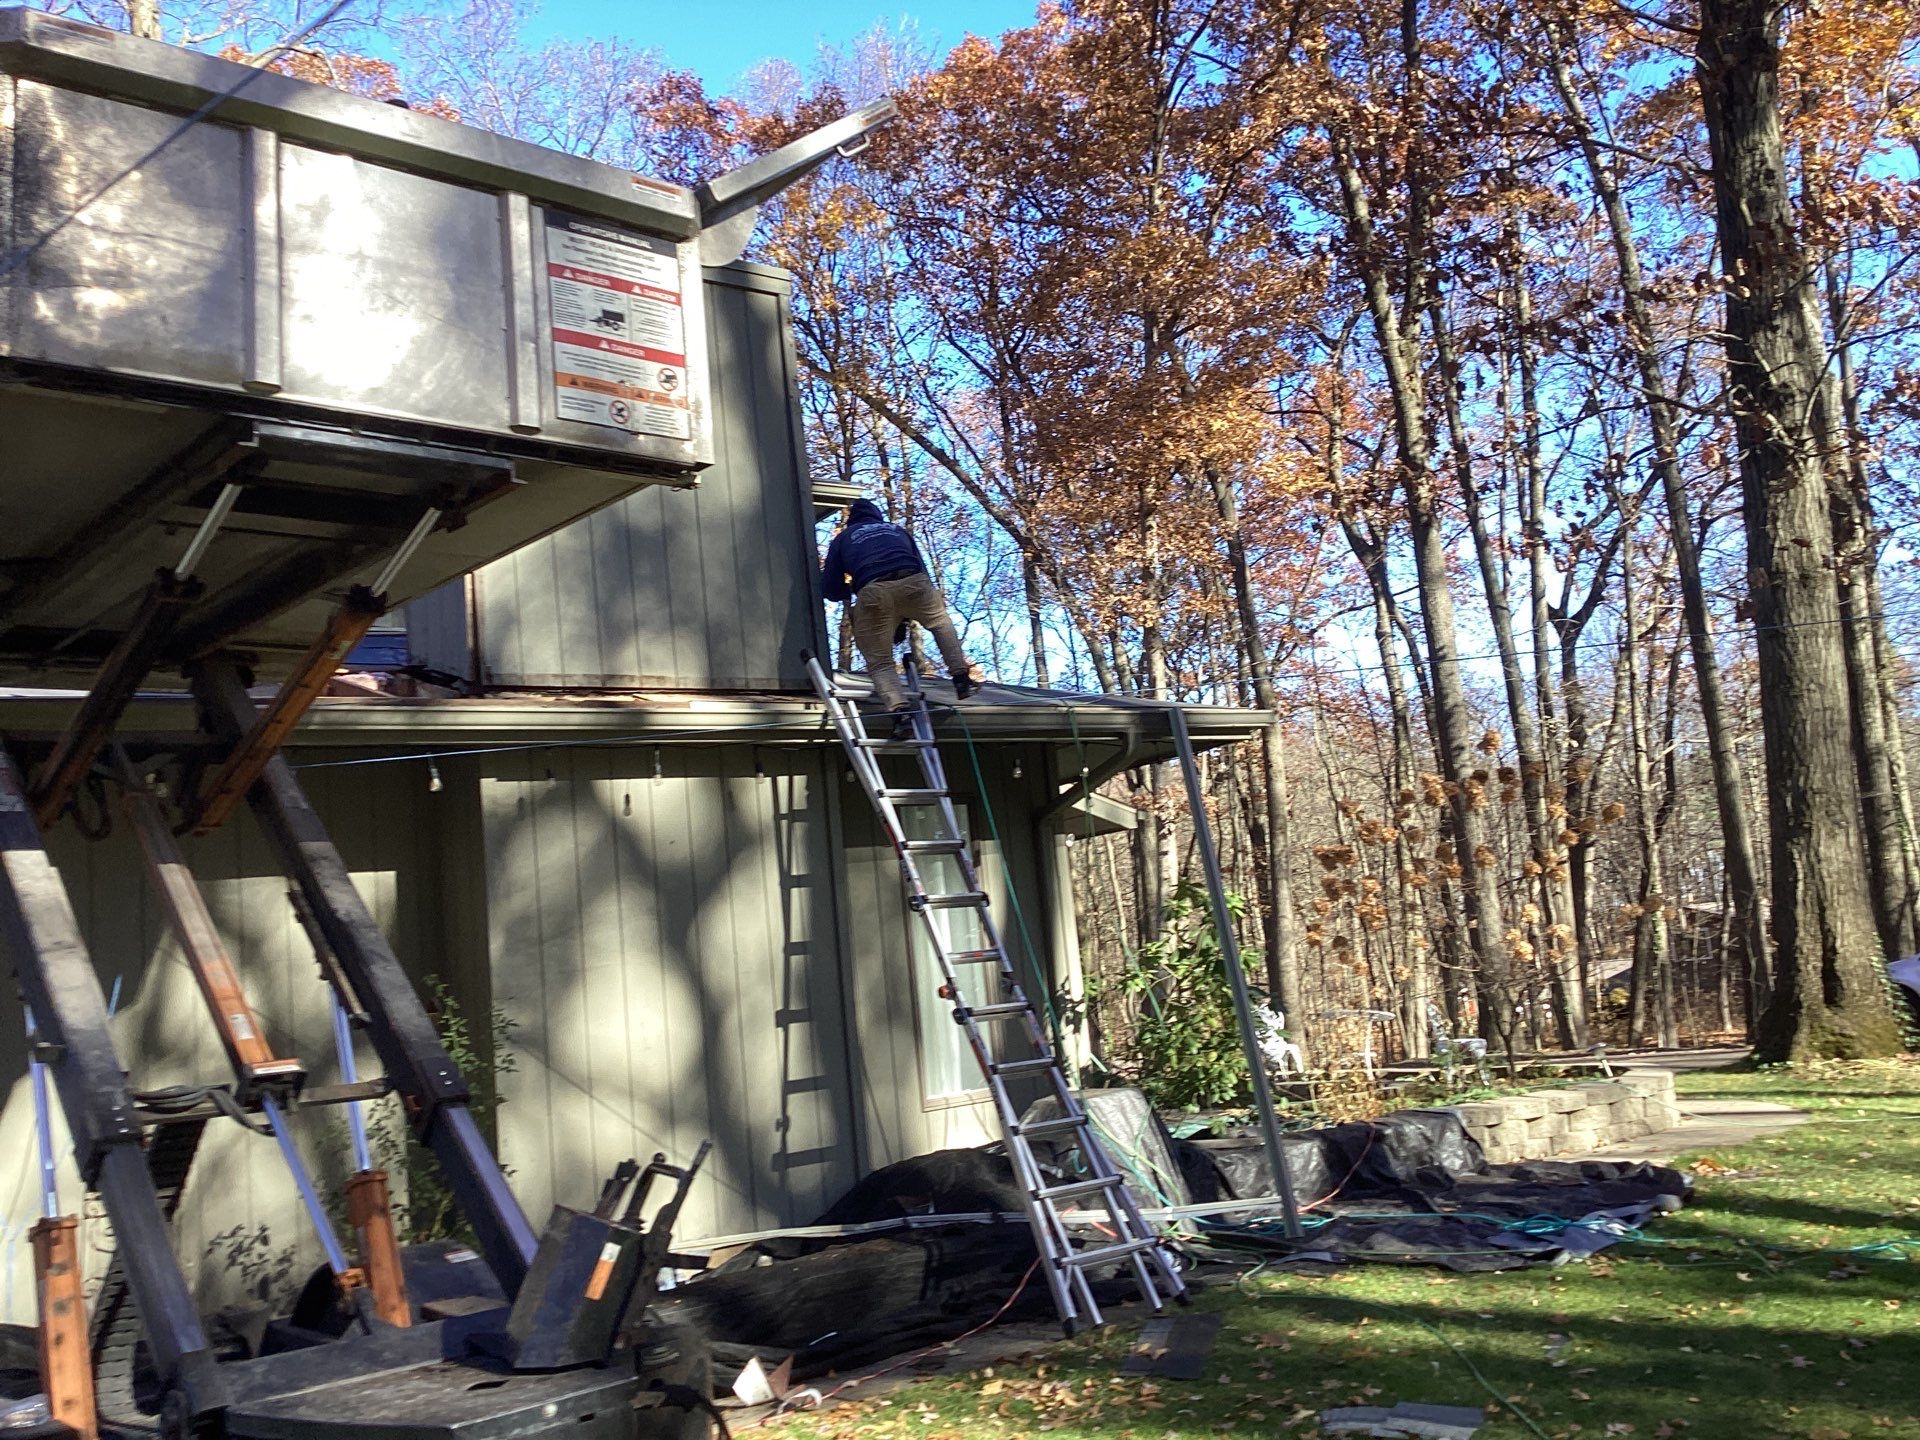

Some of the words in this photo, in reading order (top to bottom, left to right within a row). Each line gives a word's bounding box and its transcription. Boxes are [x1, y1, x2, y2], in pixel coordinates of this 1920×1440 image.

[573, 272, 612, 287] DANGER
[641, 288, 677, 303] DANGER
[610, 343, 646, 358] DANGER
